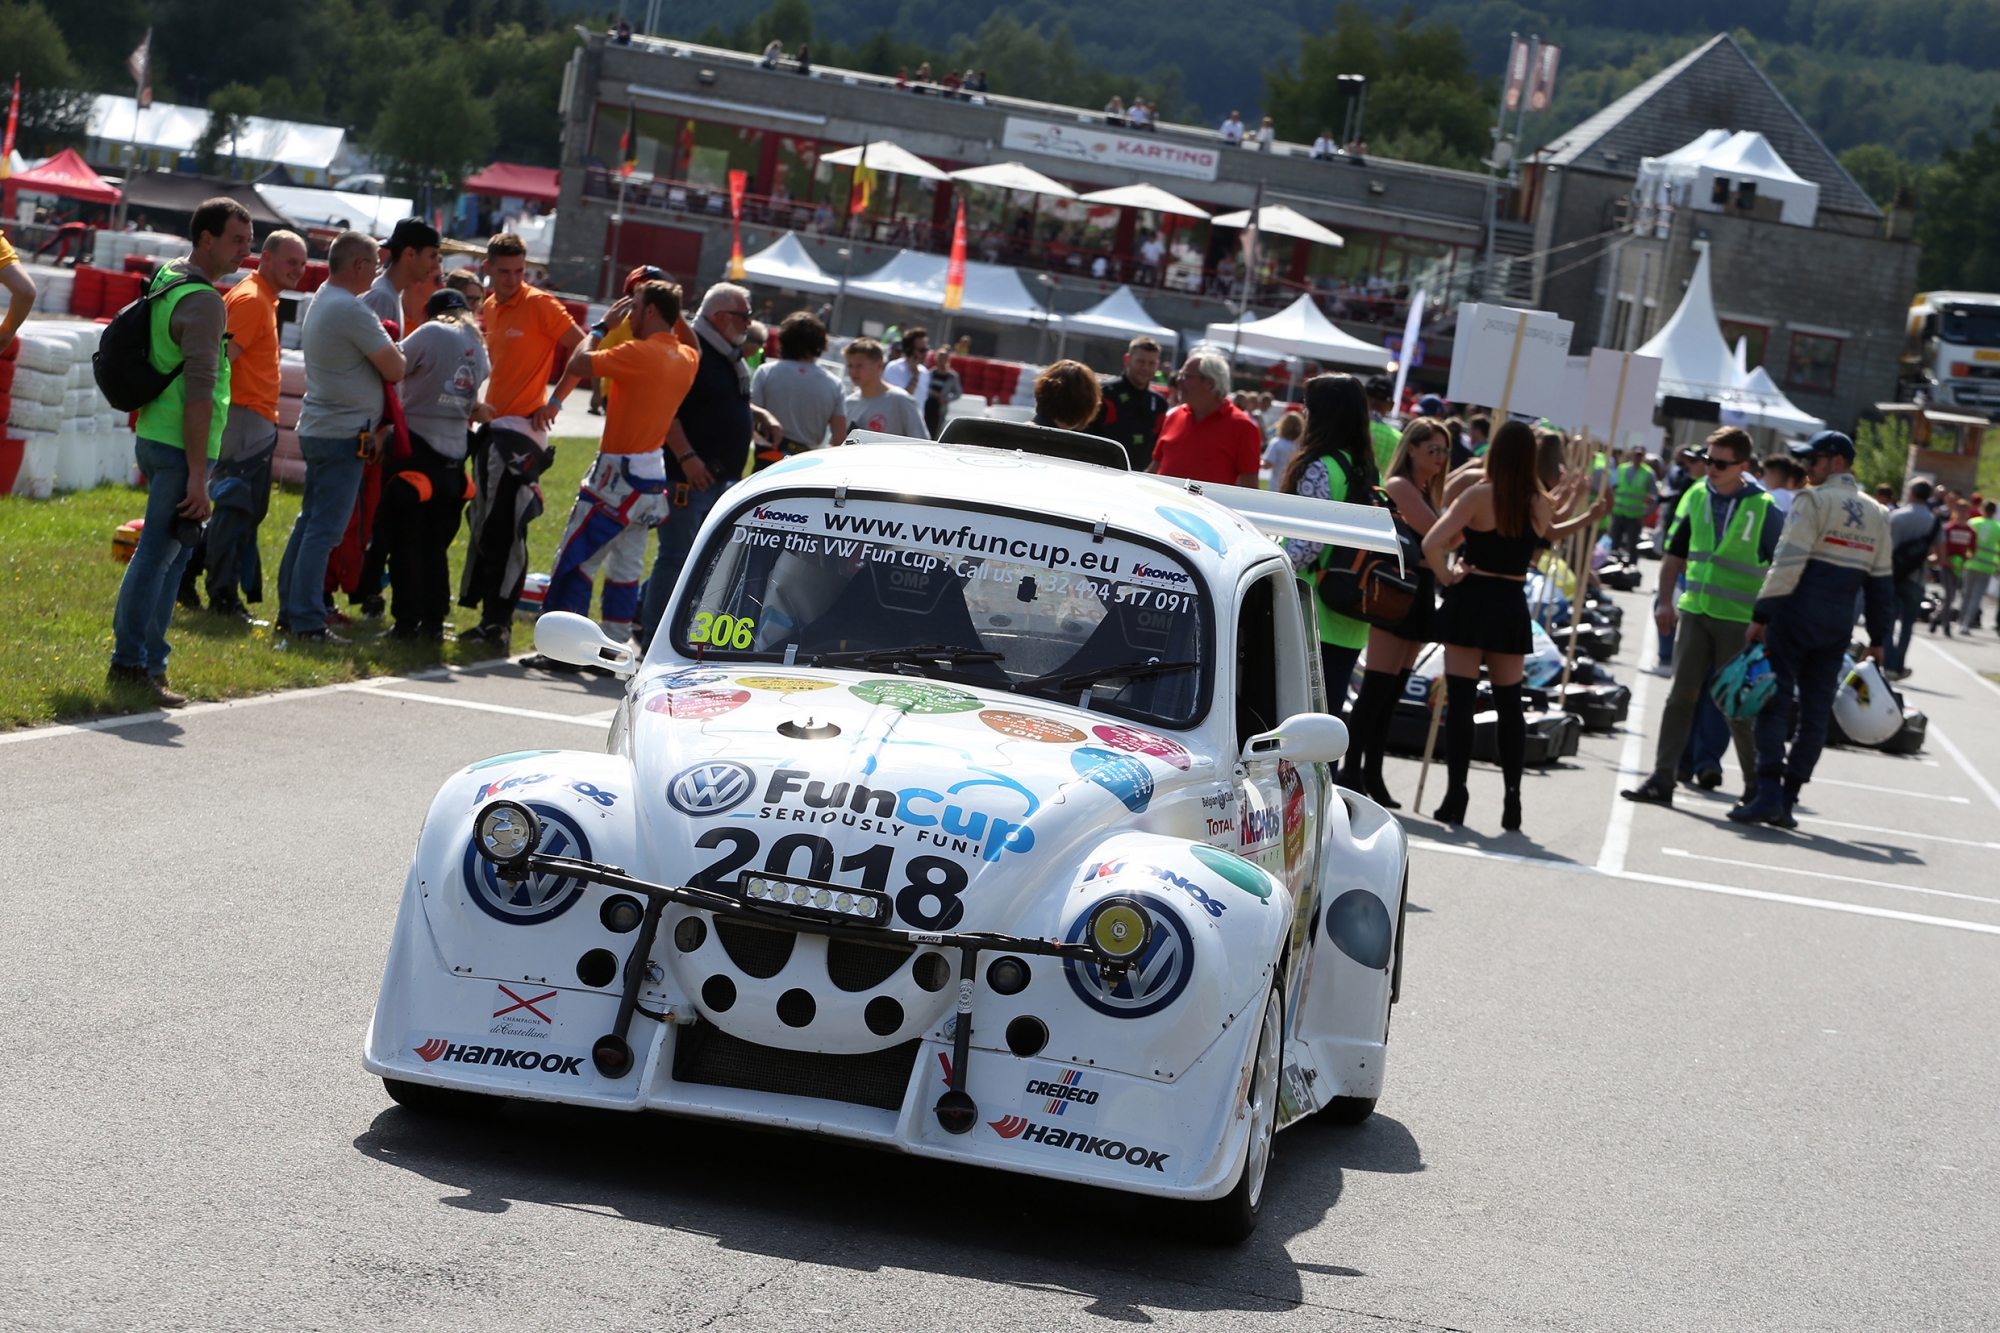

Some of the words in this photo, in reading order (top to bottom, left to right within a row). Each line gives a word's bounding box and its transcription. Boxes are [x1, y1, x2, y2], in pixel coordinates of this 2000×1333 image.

[1116, 140, 1213, 168] KARTING
[752, 505, 809, 524] KRONOS
[824, 512, 1119, 574] www.vwfuncup.eu
[732, 526, 779, 549] Drive
[784, 533, 818, 554] this
[823, 538, 861, 558] VW
[860, 543, 896, 564] Fun
[900, 551, 938, 574] Cup
[955, 559, 989, 580] Call
[992, 567, 1014, 584] us
[1035, 574, 1070, 595] +32
[1075, 582, 1110, 601] 494
[1114, 585, 1151, 607] 517
[1155, 592, 1190, 614] 091
[889, 570, 930, 589] OMP
[1131, 562, 1189, 584] KRONOS
[689, 611, 755, 649] 306
[1001, 726, 1043, 740] 10H
[1201, 796, 1218, 809] Belgian
[1224, 790, 1235, 802] Club
[763, 769, 1036, 863] FunCup
[1206, 818, 1235, 836] TOTAL
[759, 806, 904, 836] SERIOUSLY
[916, 829, 980, 858] FUN!
[686, 826, 969, 932] 2018
[490, 1024, 501, 1034] de
[499, 1021, 549, 1039] Castellane
[502, 1016, 541, 1026] CHAMPAGNE
[1025, 1079, 1100, 1105] CREDECO
